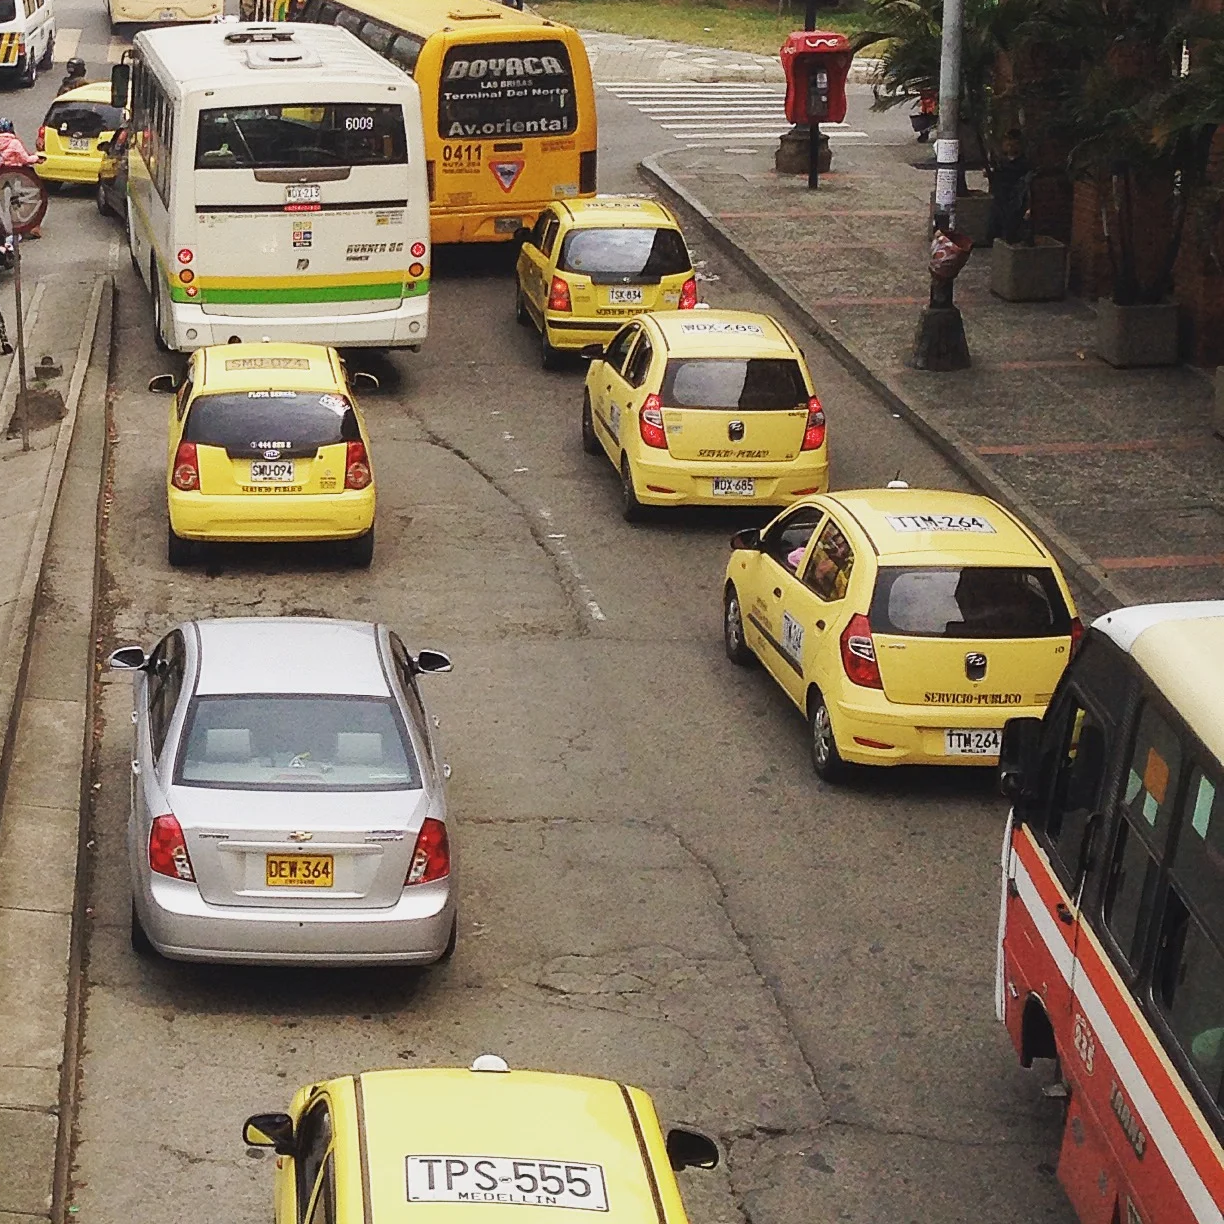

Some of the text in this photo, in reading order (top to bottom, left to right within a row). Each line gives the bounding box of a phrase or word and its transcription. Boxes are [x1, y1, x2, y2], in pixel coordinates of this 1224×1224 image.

[806, 38, 838, 47] une
[448, 56, 566, 79] BOYACA
[480, 79, 533, 89] LAS BRISAS
[443, 87, 569, 101] Terminal Del Norte
[345, 116, 373, 131] 6009
[442, 144, 482, 161] 0411
[457, 1189, 558, 1206] MEDELLIN
